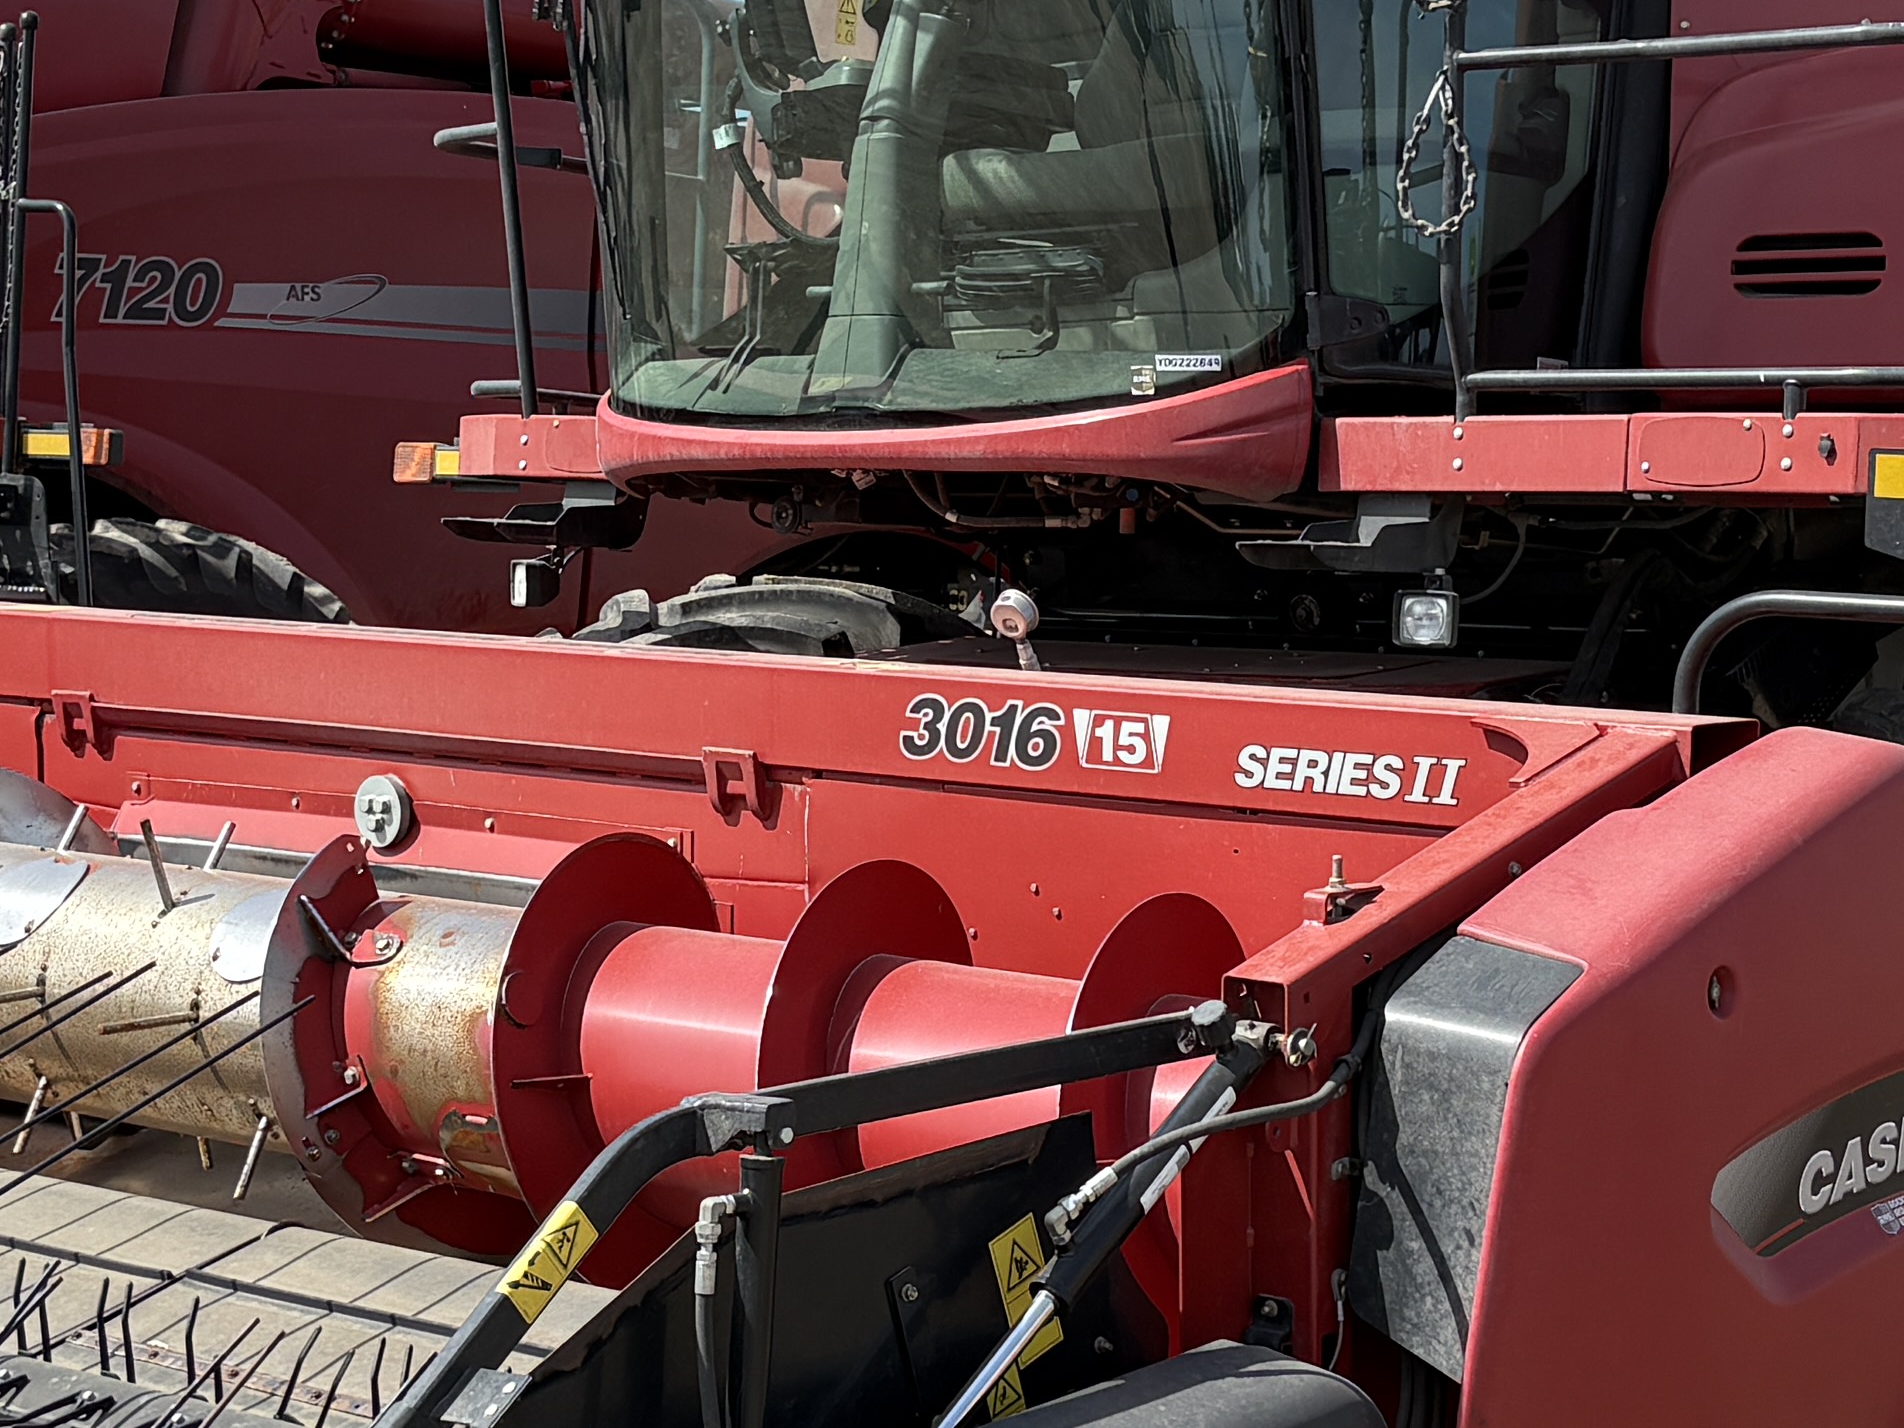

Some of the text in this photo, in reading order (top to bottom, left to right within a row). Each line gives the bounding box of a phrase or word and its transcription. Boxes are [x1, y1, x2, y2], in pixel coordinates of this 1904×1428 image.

[50, 252, 322, 327] 7120 AFS
[899, 693, 1147, 772] 3016 15
[1233, 744, 1467, 806] SERIES II
